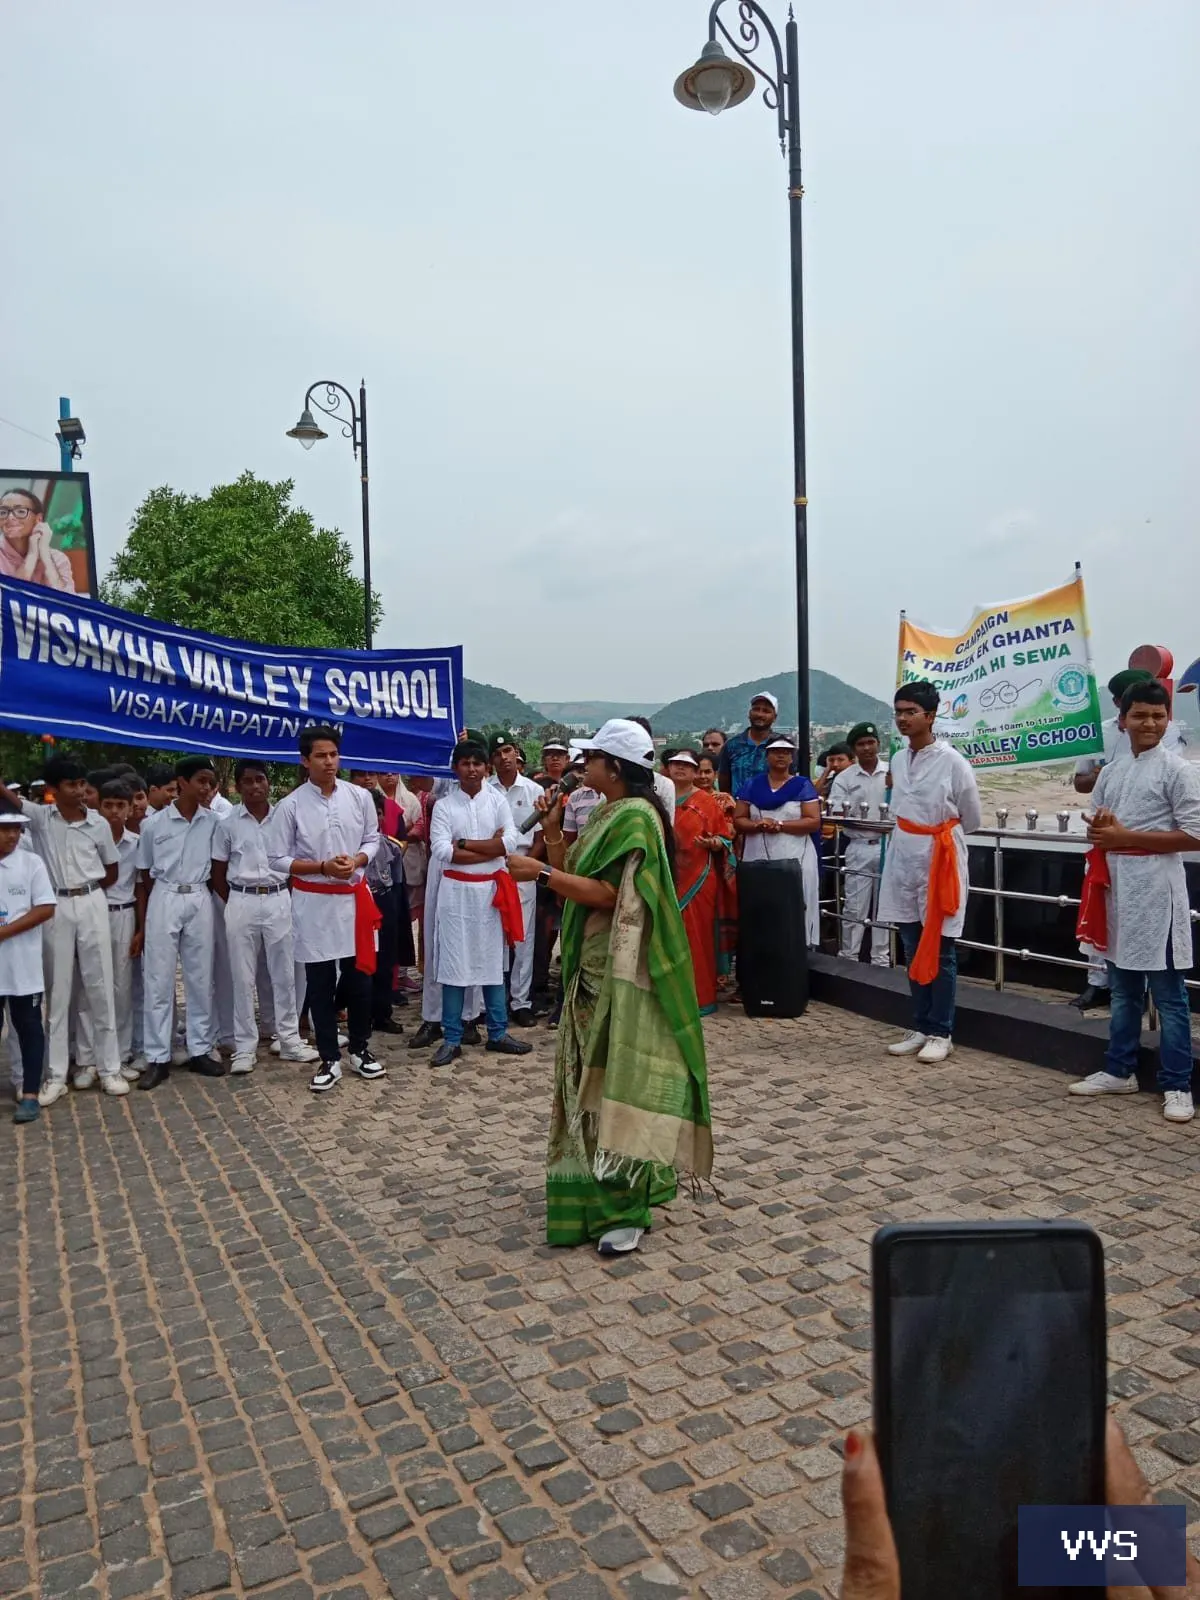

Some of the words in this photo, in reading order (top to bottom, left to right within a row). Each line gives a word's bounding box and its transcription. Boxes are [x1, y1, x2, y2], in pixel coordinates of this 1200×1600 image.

[903, 649, 917, 664] K
[976, 640, 989, 659] EK
[992, 618, 1076, 649] GHANTA
[955, 611, 1009, 655] CAMPAIGN
[9, 599, 176, 686] VISAKHA
[178, 646, 313, 712] VALLEY
[324, 668, 448, 720] SCHOOL
[990, 655, 1006, 672] HI
[1013, 643, 1072, 666] SEWA
[977, 726, 997, 735] Time
[1000, 722, 1024, 732] 10am
[1038, 716, 1063, 725] 11am
[962, 735, 1021, 755] VALLEY
